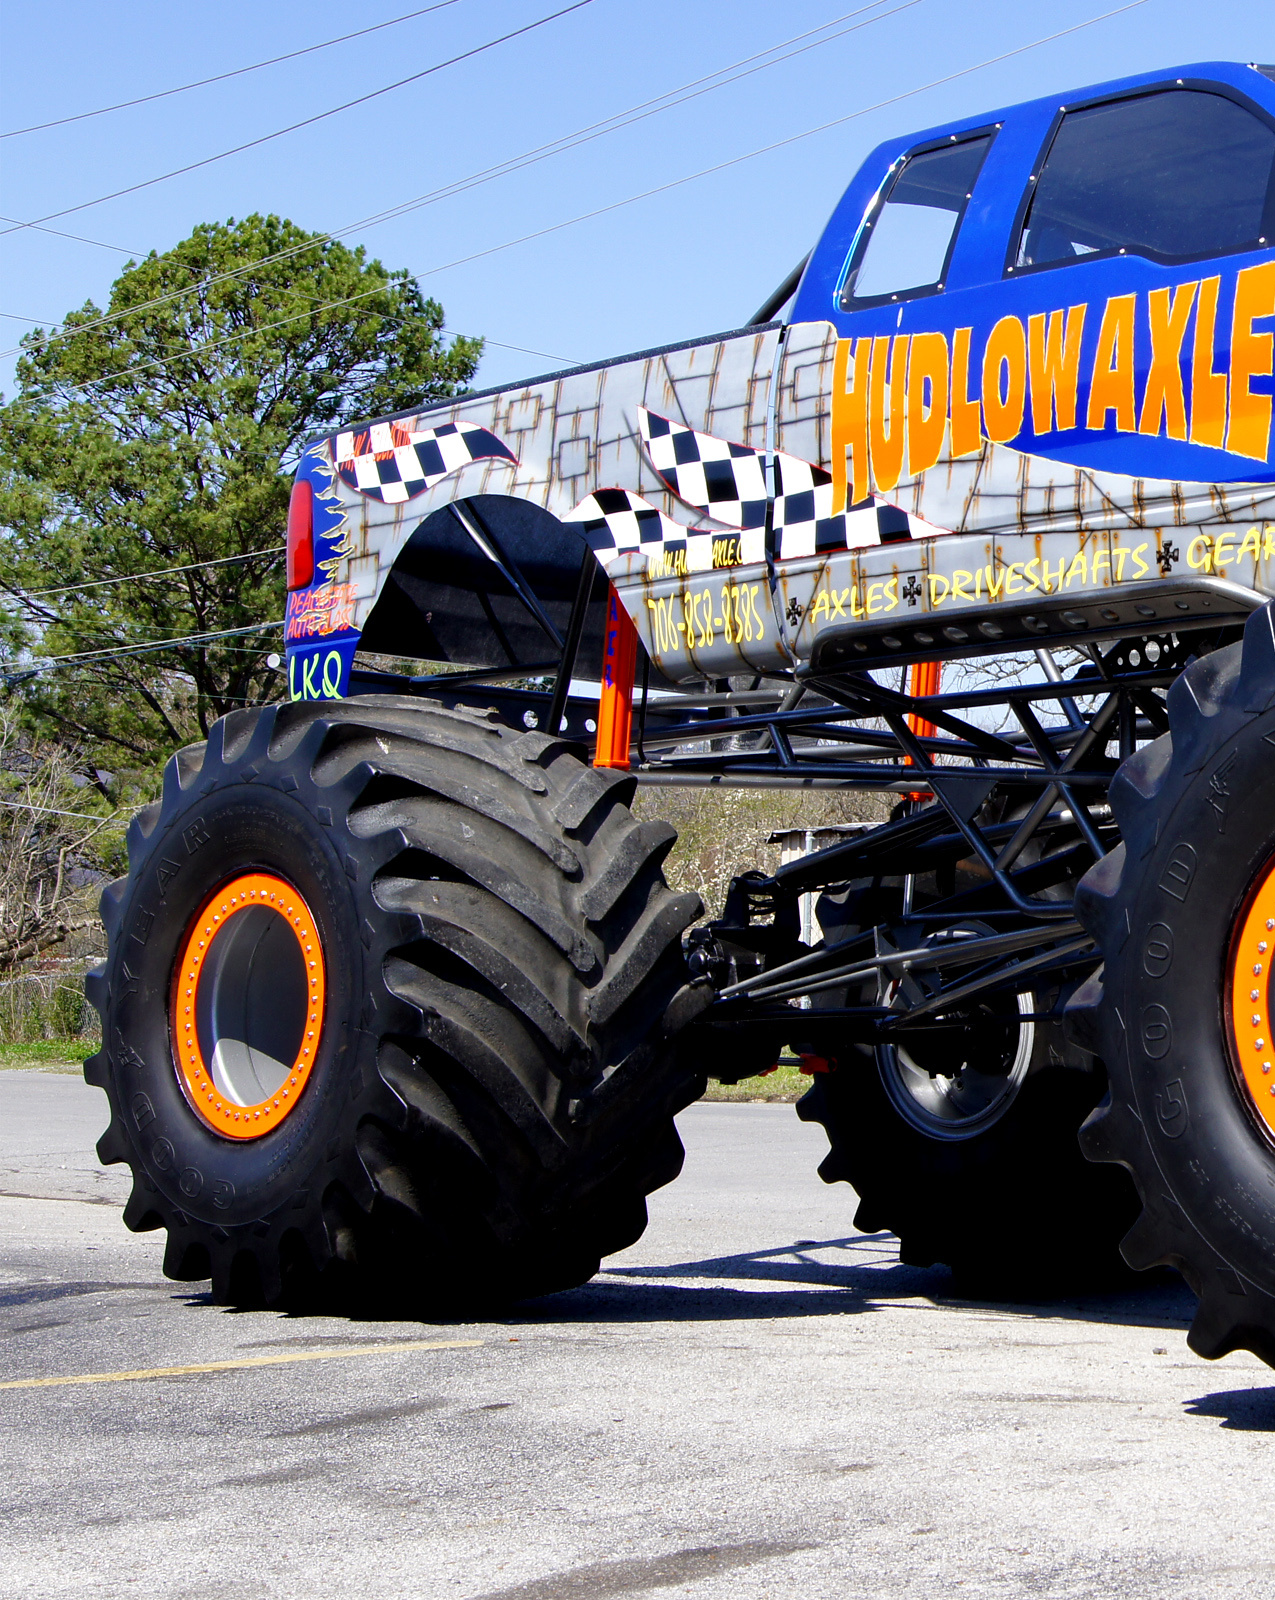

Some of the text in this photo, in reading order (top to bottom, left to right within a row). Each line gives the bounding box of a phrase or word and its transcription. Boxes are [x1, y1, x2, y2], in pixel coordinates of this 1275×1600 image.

[648, 583, 764, 655] 706-858-8385
[811, 577, 898, 623] AXLES
[927, 543, 1150, 607] DRIVESHAFTS
[289, 650, 343, 701] LKQ
